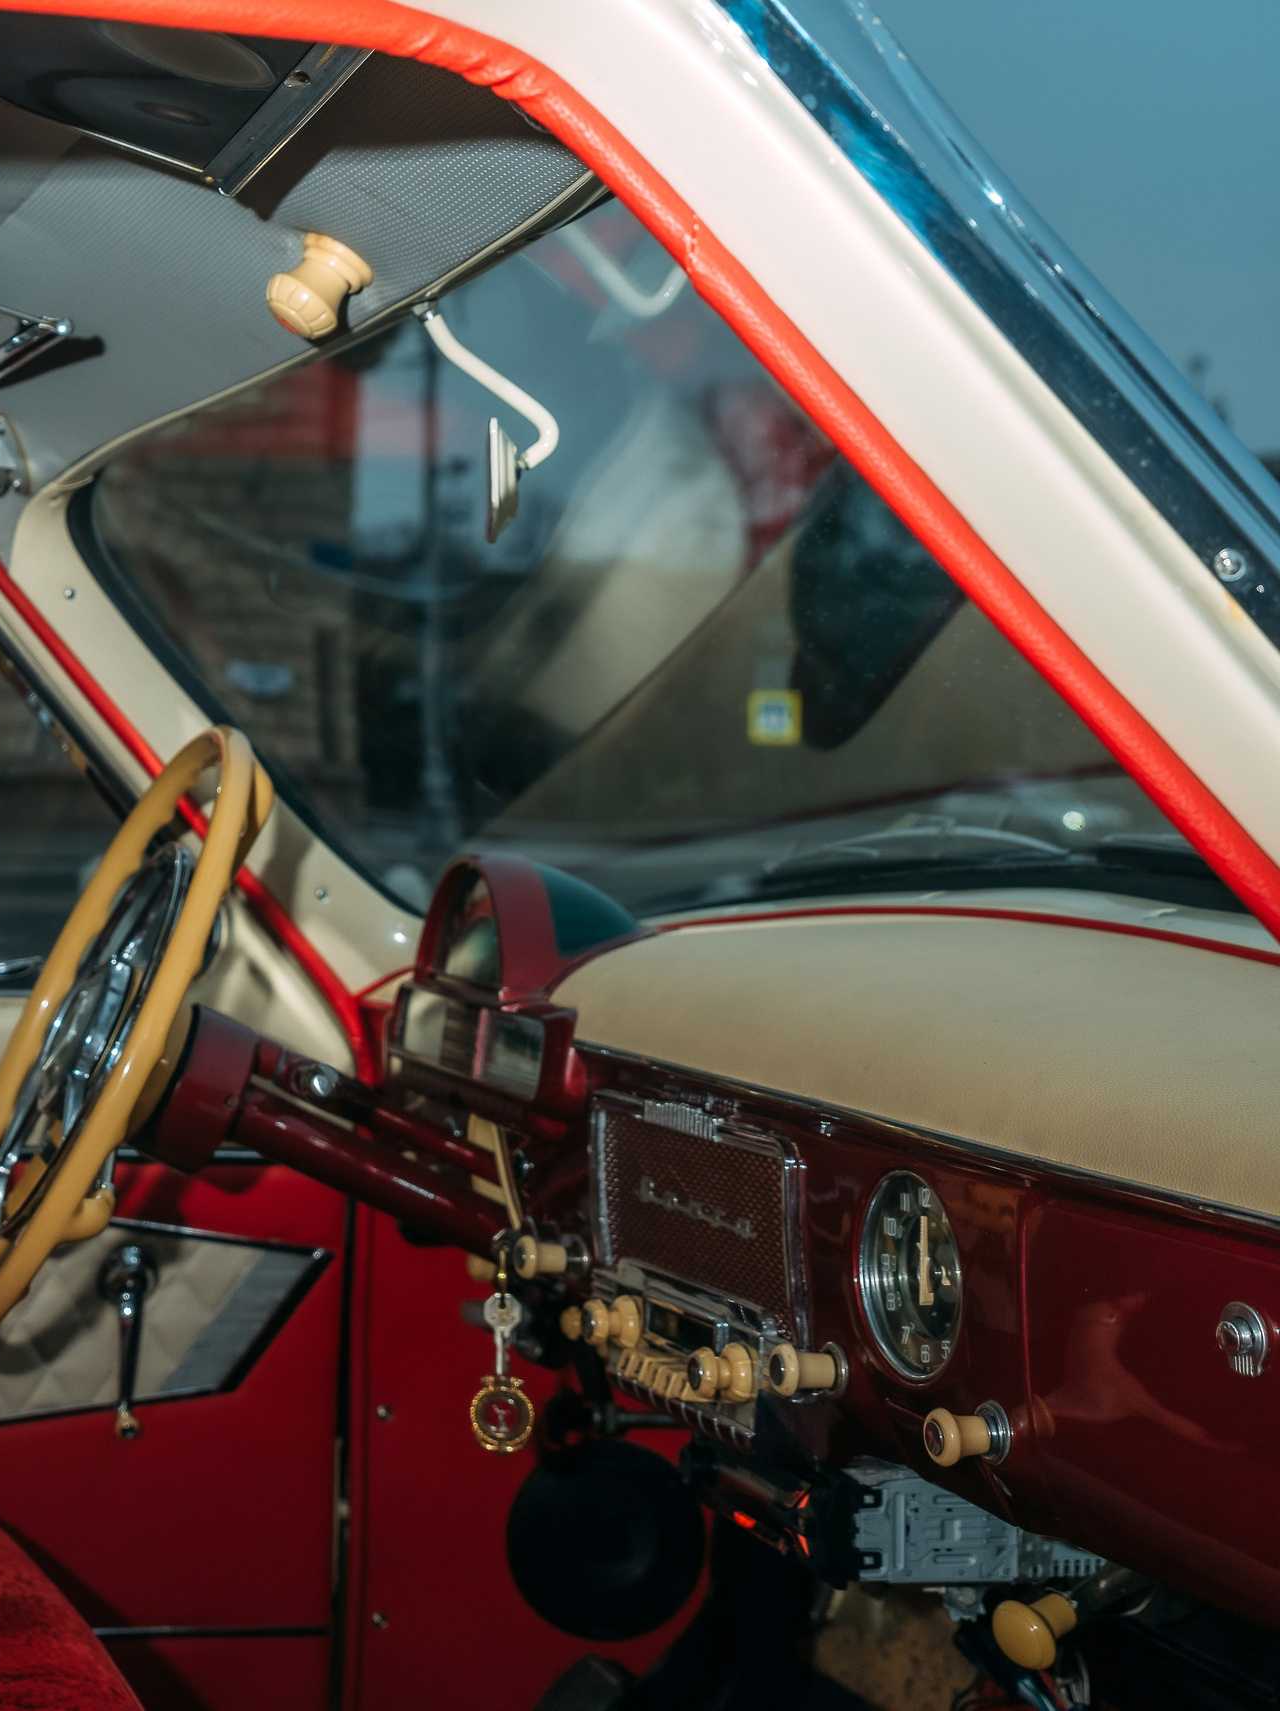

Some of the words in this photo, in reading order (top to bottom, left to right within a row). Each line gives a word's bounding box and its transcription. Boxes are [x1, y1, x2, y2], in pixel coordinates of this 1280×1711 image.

[918, 1187, 931, 1207] 12
[884, 1216, 897, 1236] 10
[881, 1253, 890, 1271] 9
[886, 1292, 896, 1311] 8
[901, 1325, 910, 1344] 7
[921, 1344, 930, 1363] 6
